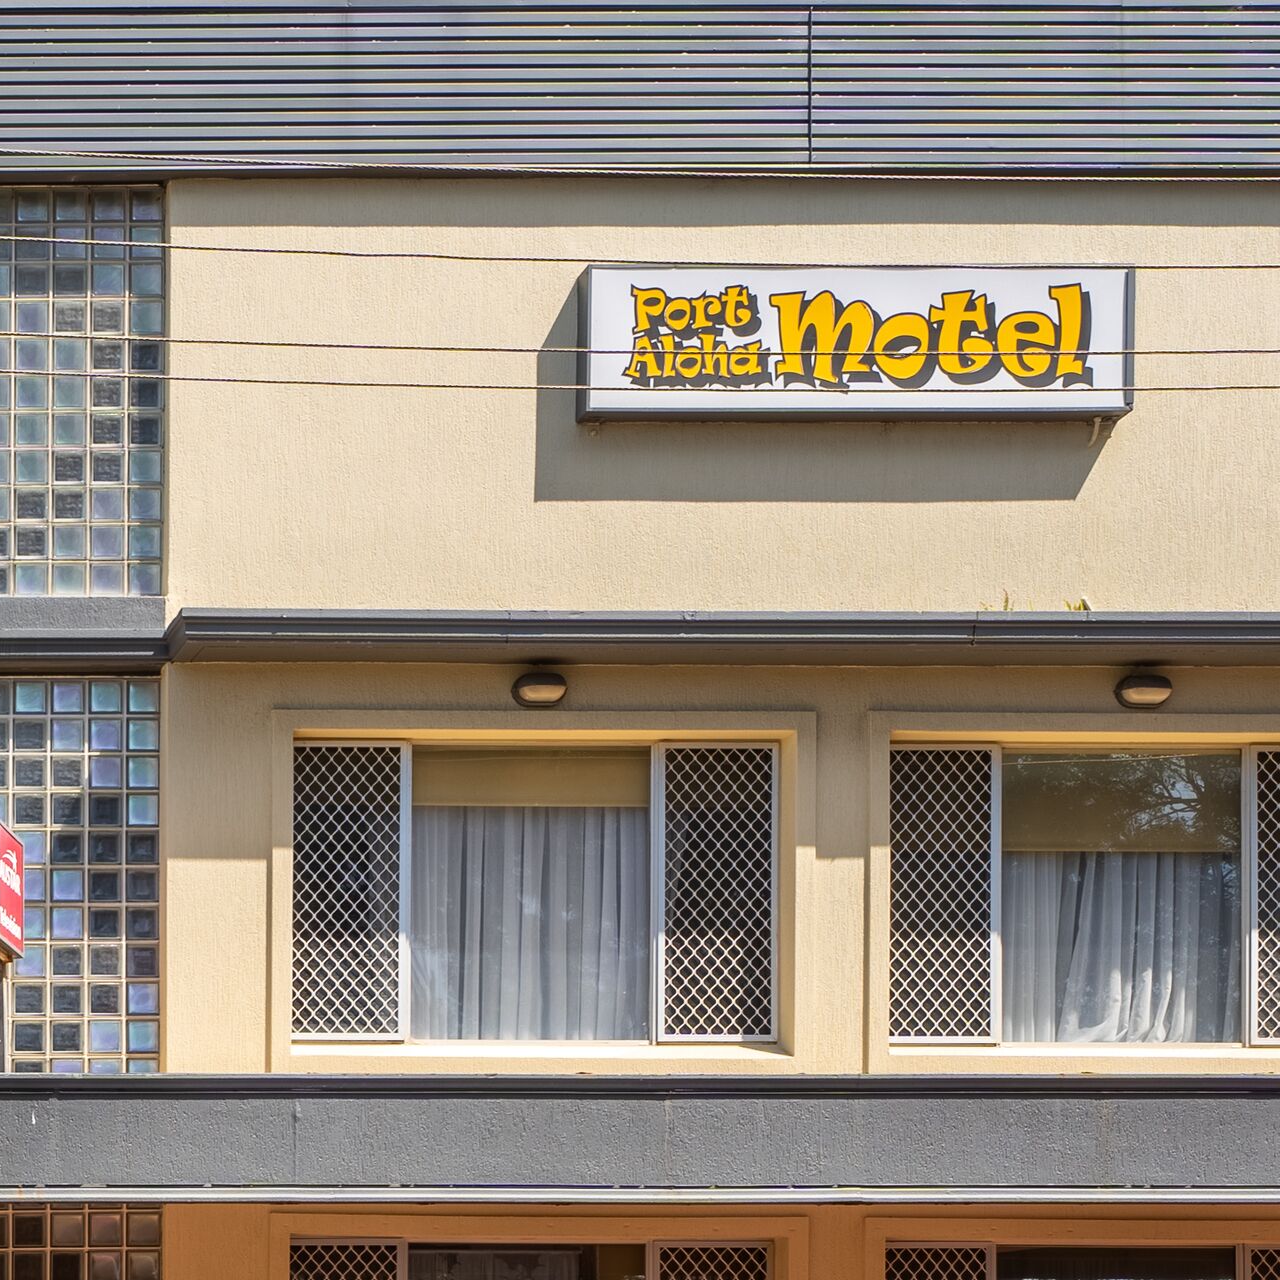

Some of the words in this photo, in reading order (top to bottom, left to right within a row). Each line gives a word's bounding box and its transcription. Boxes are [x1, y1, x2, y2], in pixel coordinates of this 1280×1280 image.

[630, 284, 755, 338] Port
[770, 282, 1094, 390] Motel
[624, 332, 774, 388] Aloha
